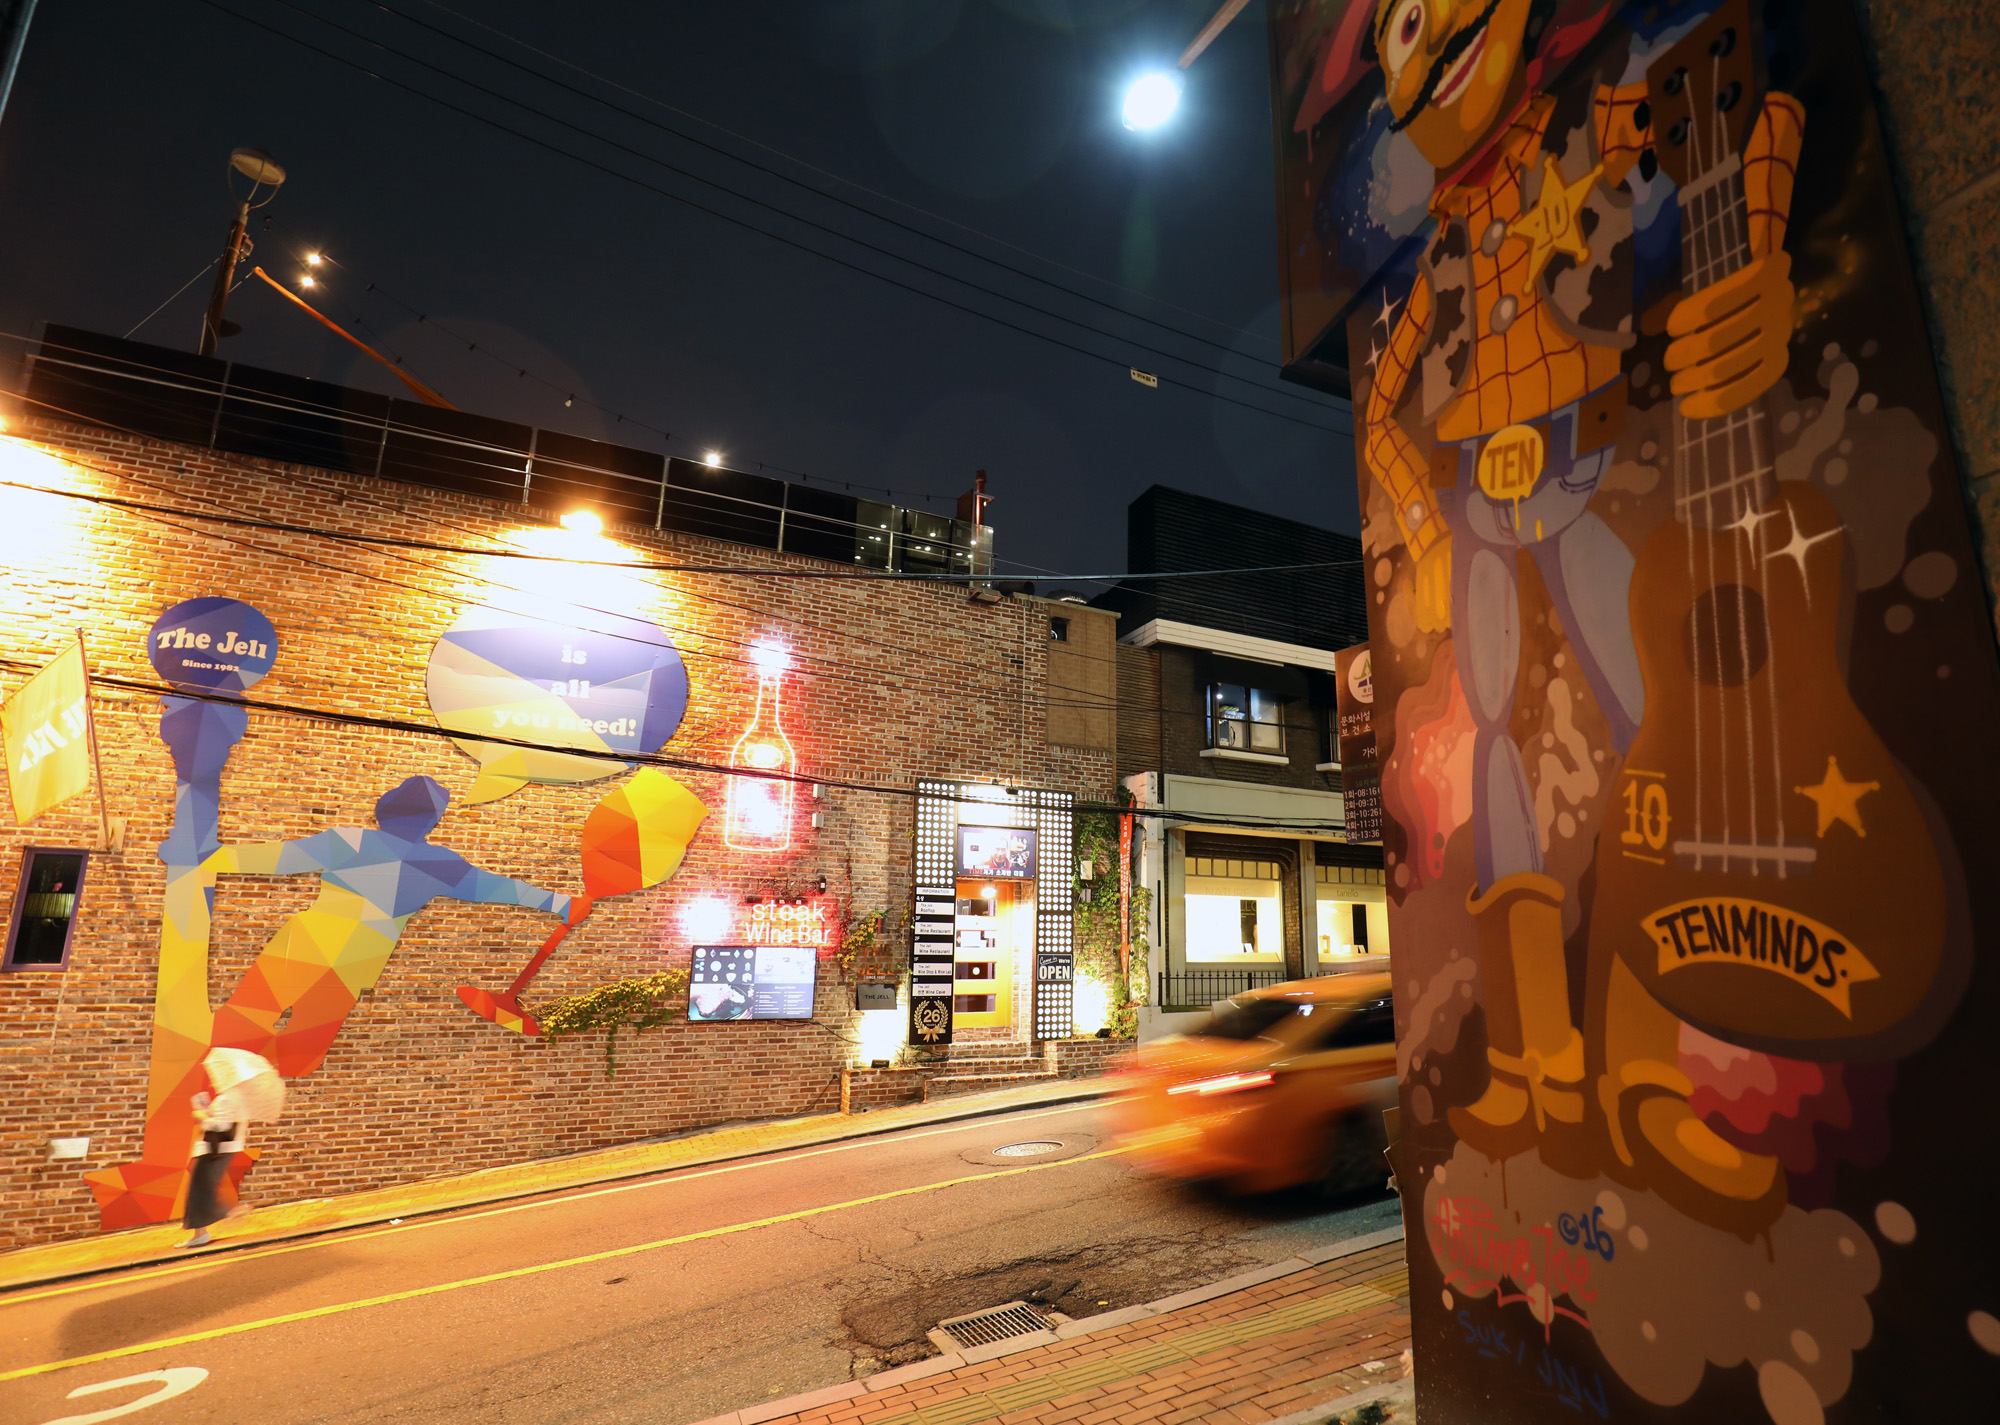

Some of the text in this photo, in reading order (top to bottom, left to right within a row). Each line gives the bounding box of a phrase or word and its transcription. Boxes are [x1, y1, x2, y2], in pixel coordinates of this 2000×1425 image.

[1486, 438, 1537, 491] TEN
[157, 627, 268, 659] The Jell
[182, 659, 212, 669] Since
[561, 644, 588, 665] is
[550, 679, 591, 700] all
[492, 709, 638, 738] you need!
[1340, 710, 1371, 727] 문화시설
[1621, 779, 1672, 851] 10
[752, 900, 826, 922] steak
[745, 922, 831, 944] Wine Bar
[857, 962, 896, 976] JELL
[1039, 965, 1071, 980] OPEN
[923, 1009, 941, 1023] 26
